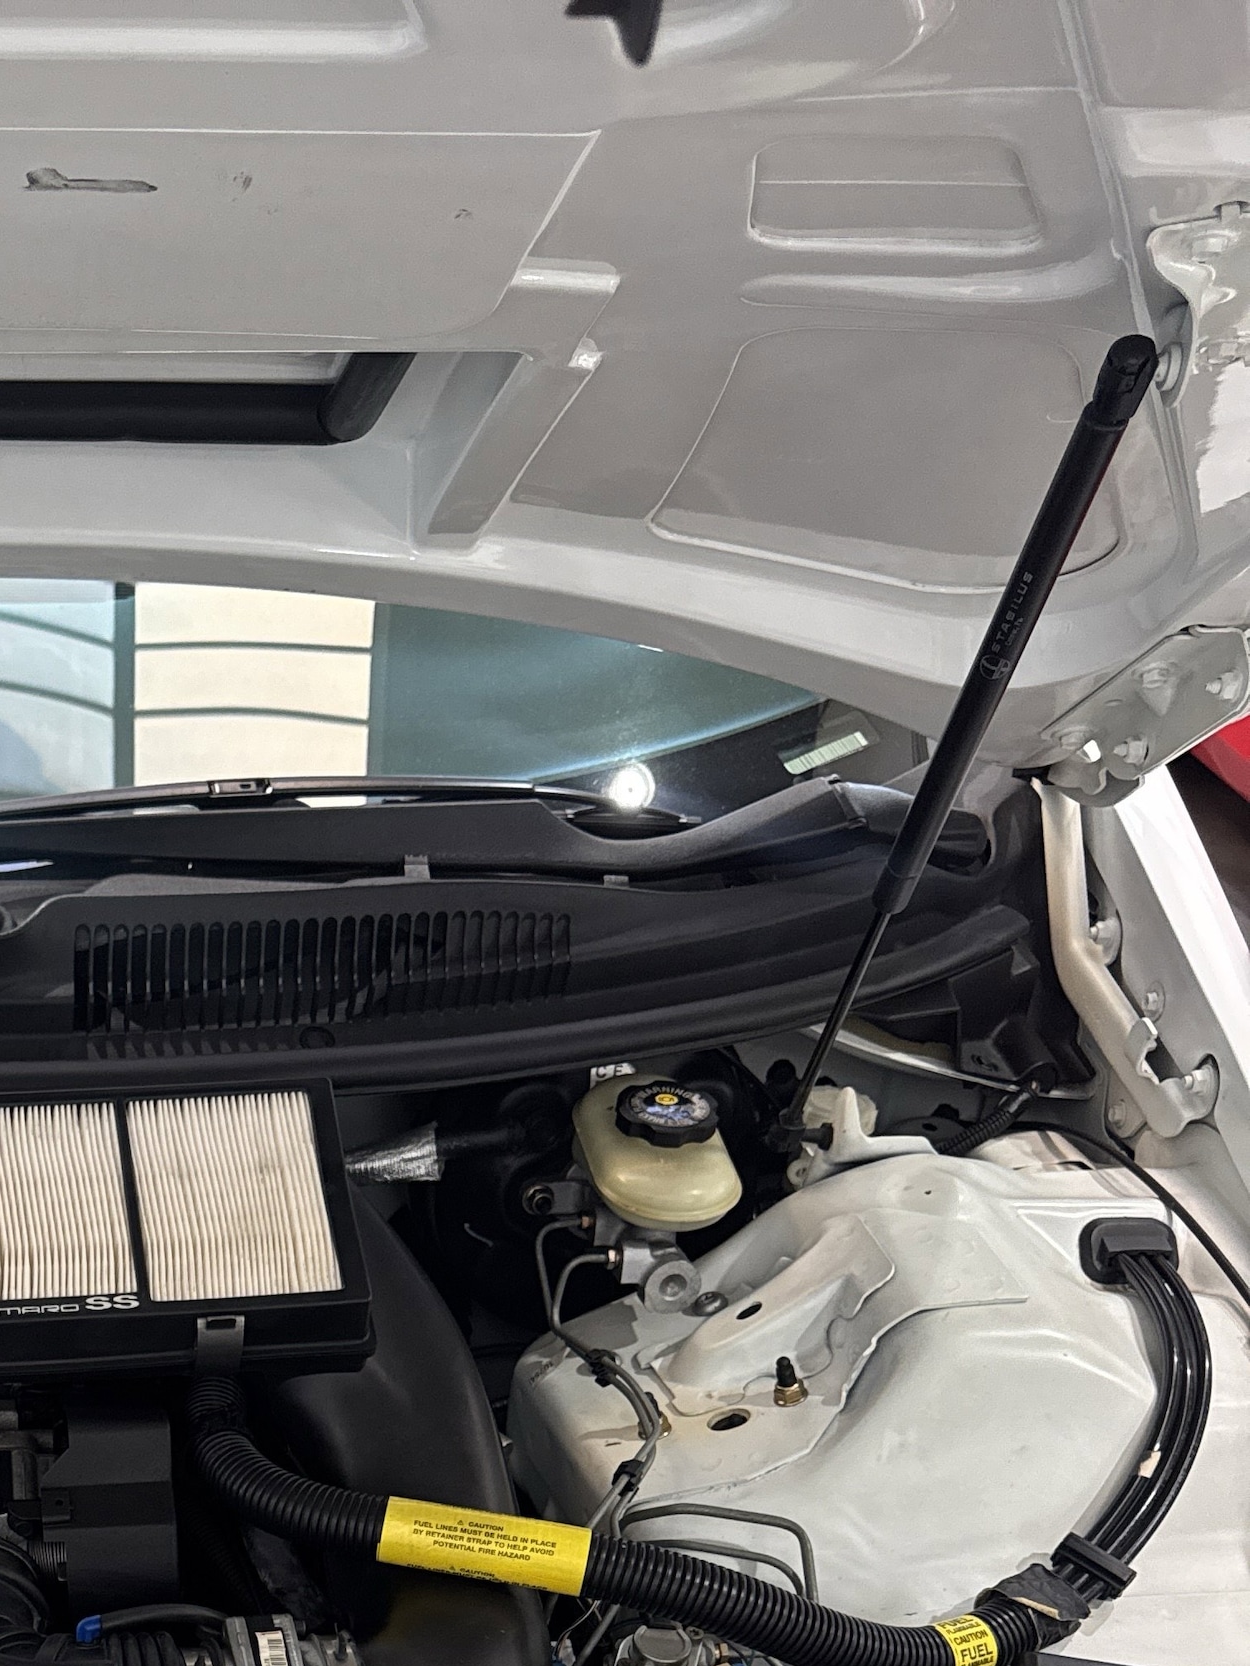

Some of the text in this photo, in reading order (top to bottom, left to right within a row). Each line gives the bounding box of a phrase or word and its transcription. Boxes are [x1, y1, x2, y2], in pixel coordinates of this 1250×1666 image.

[992, 572, 1033, 653] STABILUS
[85, 1295, 140, 1310] SS
[413, 1520, 434, 1529] FUEL
[436, 1523, 458, 1532] LINES
[460, 1527, 483, 1537] MUST
[484, 1531, 495, 1539] BE
[497, 1533, 518, 1542] HELD
[530, 1538, 556, 1548] PLACE
[468, 1521, 504, 1532] CAUTION
[425, 1530, 465, 1542] RETAINER
[466, 1536, 492, 1546] STRAP
[506, 1542, 528, 1552] HELP
[530, 1547, 555, 1556] AVOID
[433, 1540, 531, 1561] POTENTIAL FIRE HAZARD
[937, 1617, 974, 1629] FUEL
[953, 1629, 988, 1645] CAUTION
[960, 1643, 993, 1662] FUEL
